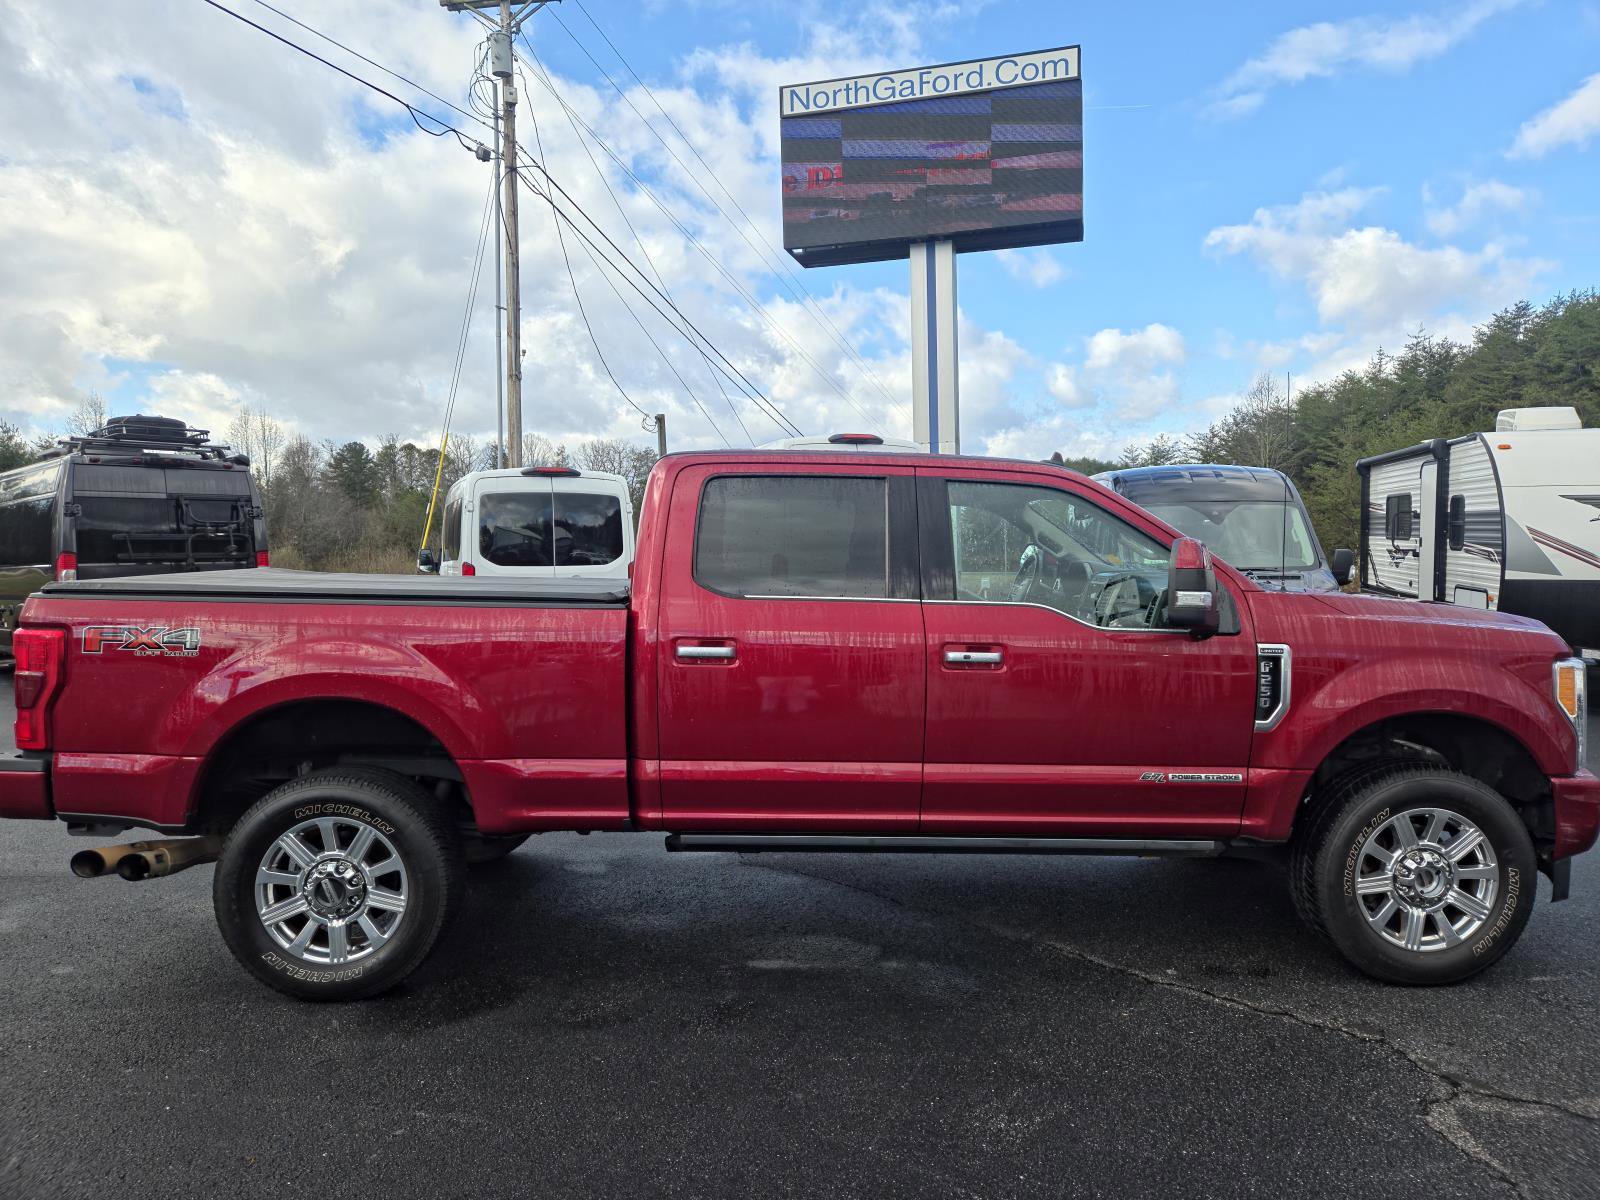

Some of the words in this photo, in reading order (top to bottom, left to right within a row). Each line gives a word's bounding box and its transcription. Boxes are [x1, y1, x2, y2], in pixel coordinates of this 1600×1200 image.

[788, 56, 1070, 113] NorthGaFord.Com
[82, 625, 201, 654] FX4
[294, 803, 396, 835] MICHELIN
[1343, 807, 1391, 897] MICHELIN
[1472, 867, 1519, 958] MICHELIN
[261, 951, 364, 983] MICHELIN
